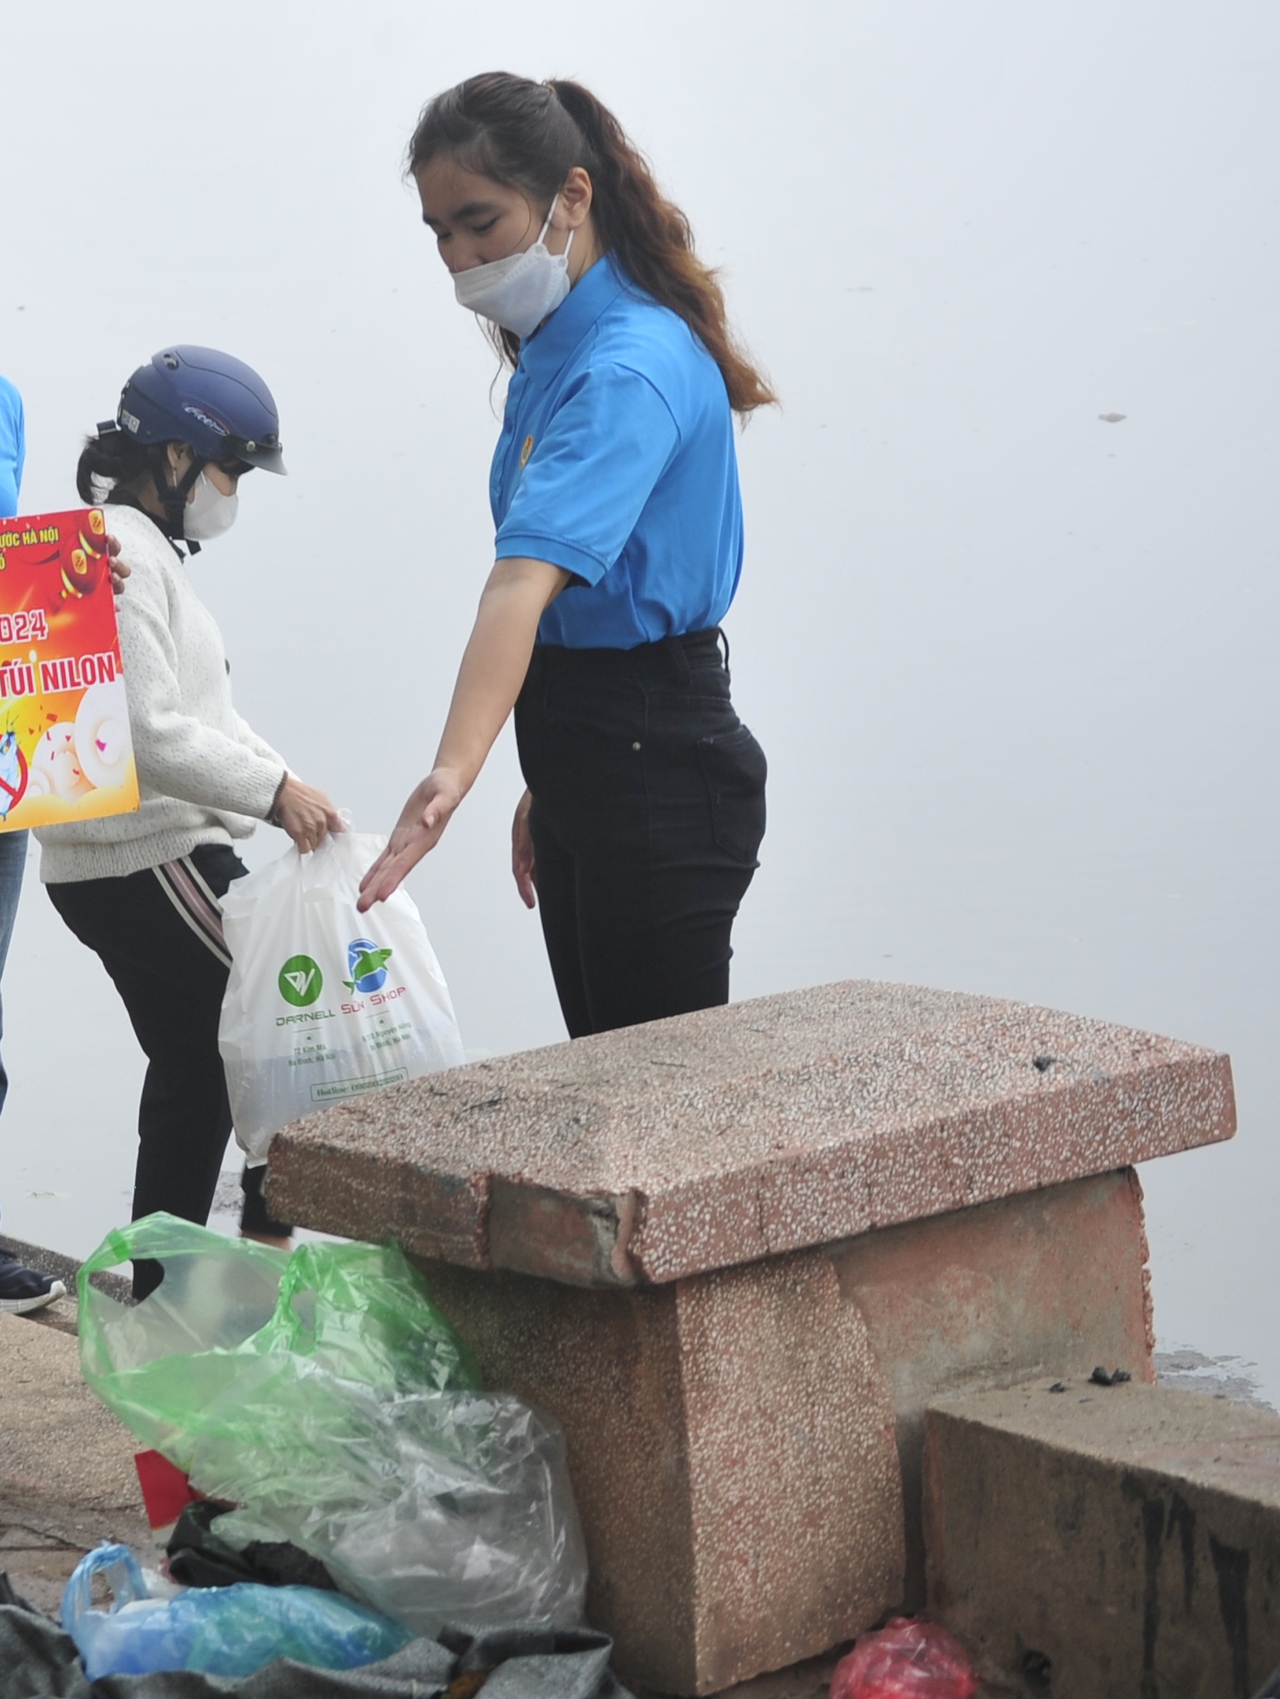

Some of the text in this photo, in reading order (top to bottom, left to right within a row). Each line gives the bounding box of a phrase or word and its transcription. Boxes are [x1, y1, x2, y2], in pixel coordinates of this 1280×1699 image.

[22, 528, 38, 545] HÀ
[39, 525, 59, 545] NỘI
[40, 653, 116, 693] NILON
[369, 986, 406, 1006] SHOP
[276, 1009, 336, 1027] DARNELL
